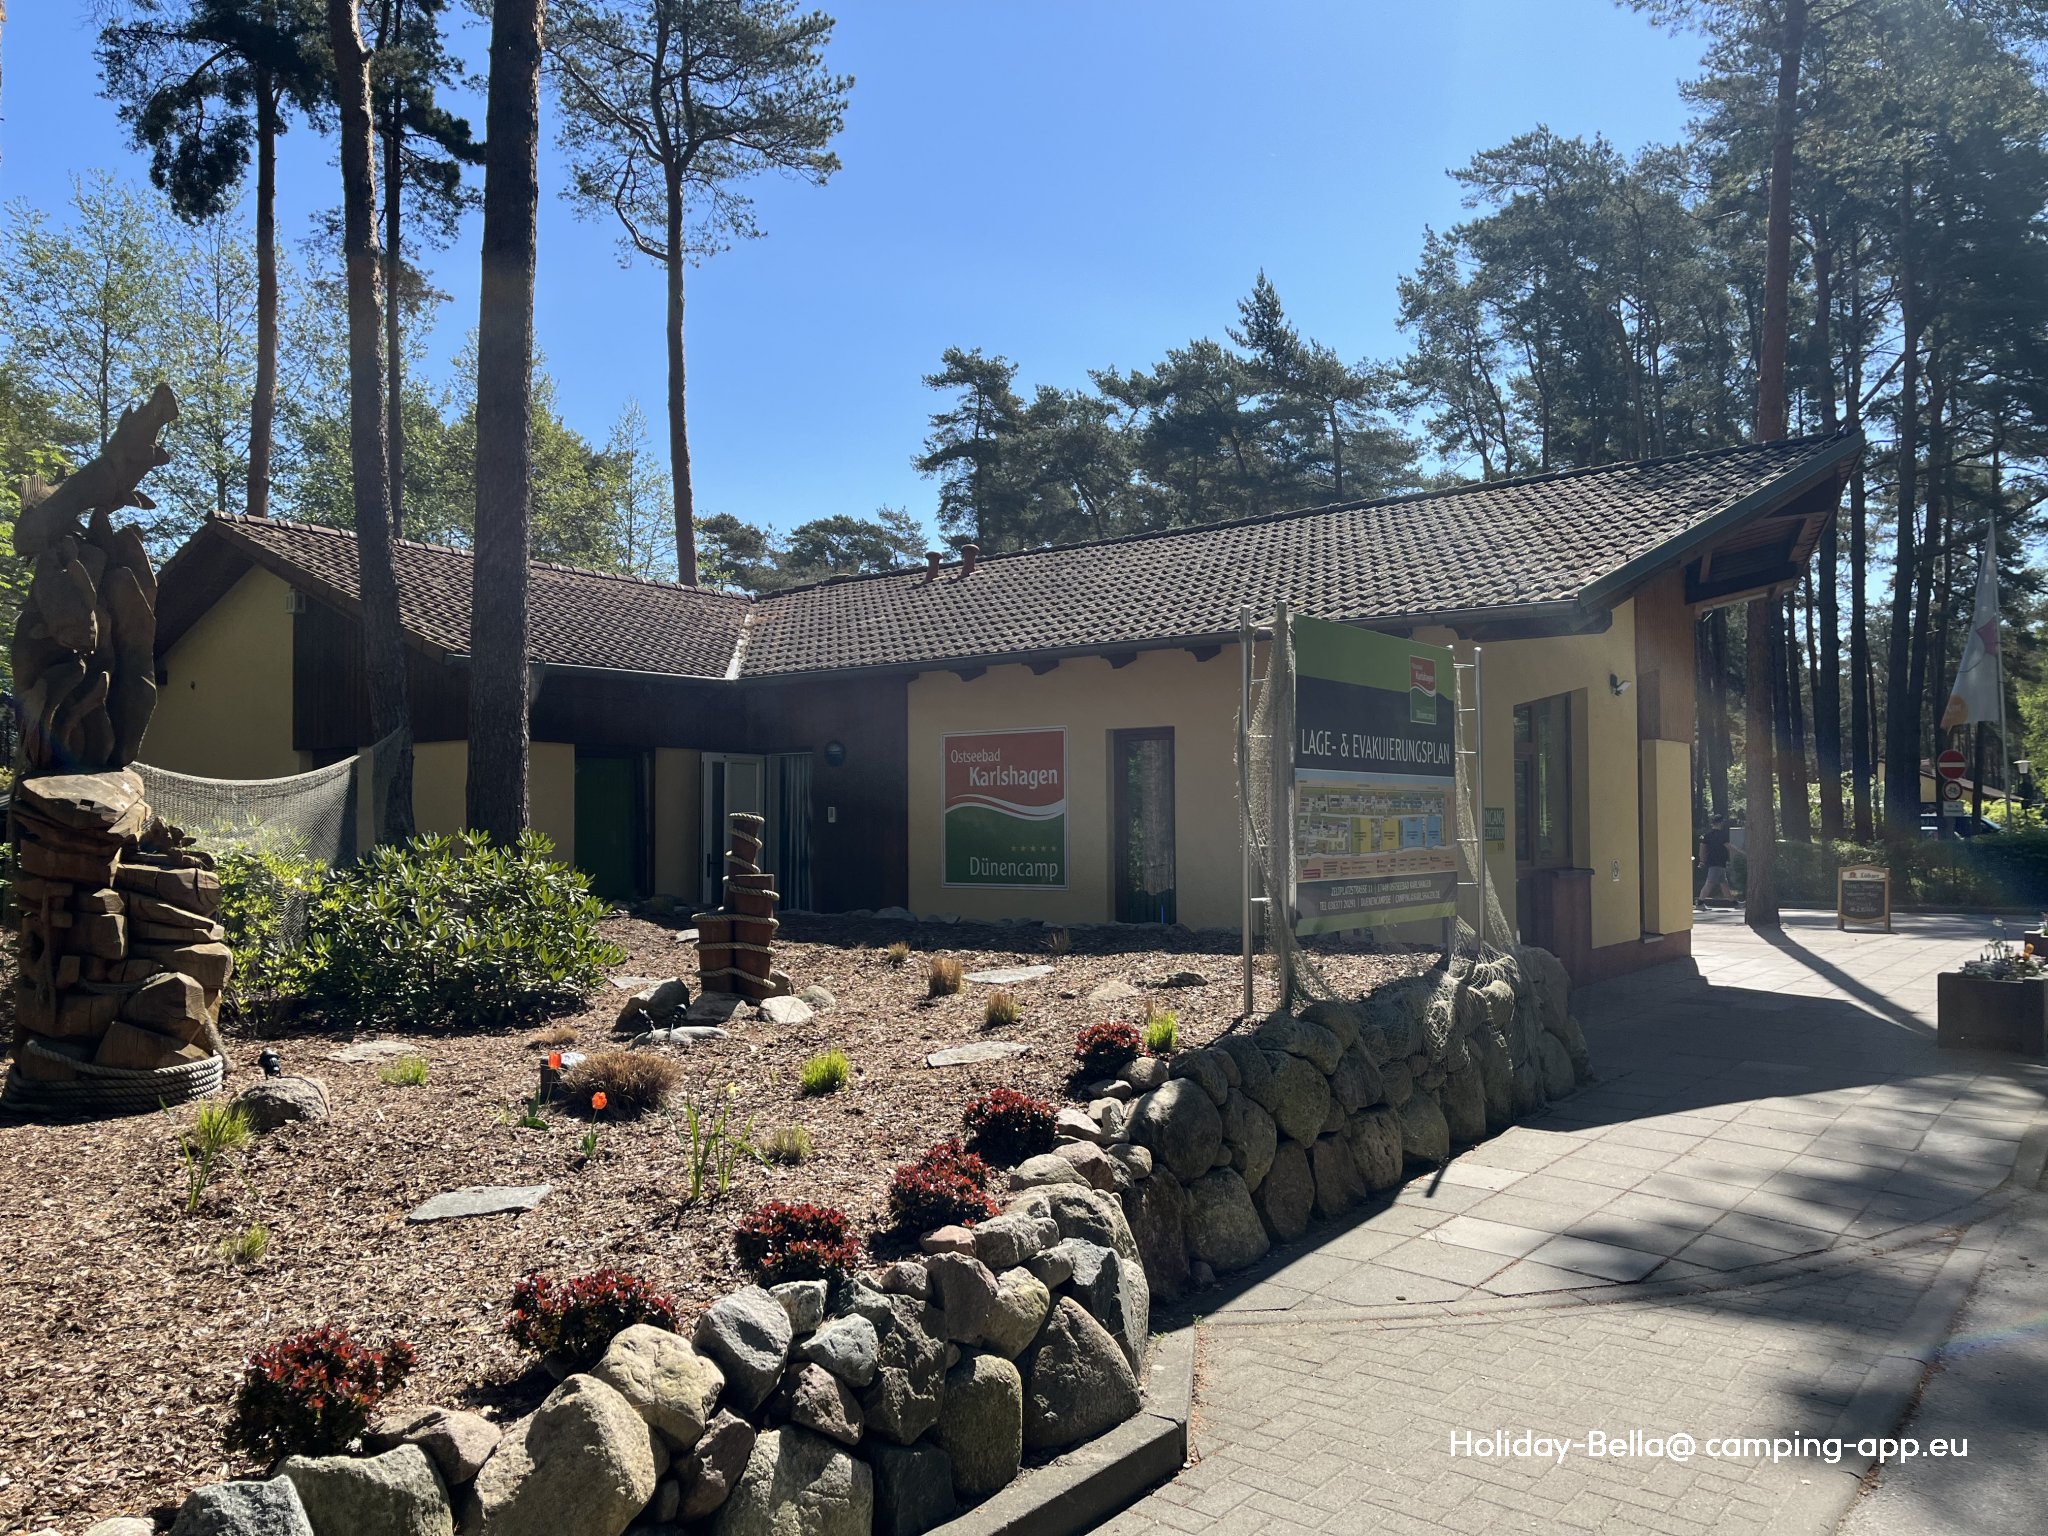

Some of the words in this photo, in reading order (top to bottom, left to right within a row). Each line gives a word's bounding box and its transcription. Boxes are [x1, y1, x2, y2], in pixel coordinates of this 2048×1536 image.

[950, 748, 1000, 763] Ostseebad
[1302, 729, 1337, 756] LAGE-
[1340, 733, 1349, 757] &
[1353, 734, 1450, 765] EVAKUIERUNGSPLAN
[969, 765, 1058, 790] Karlshagen
[969, 856, 1058, 881] Dünencamp
